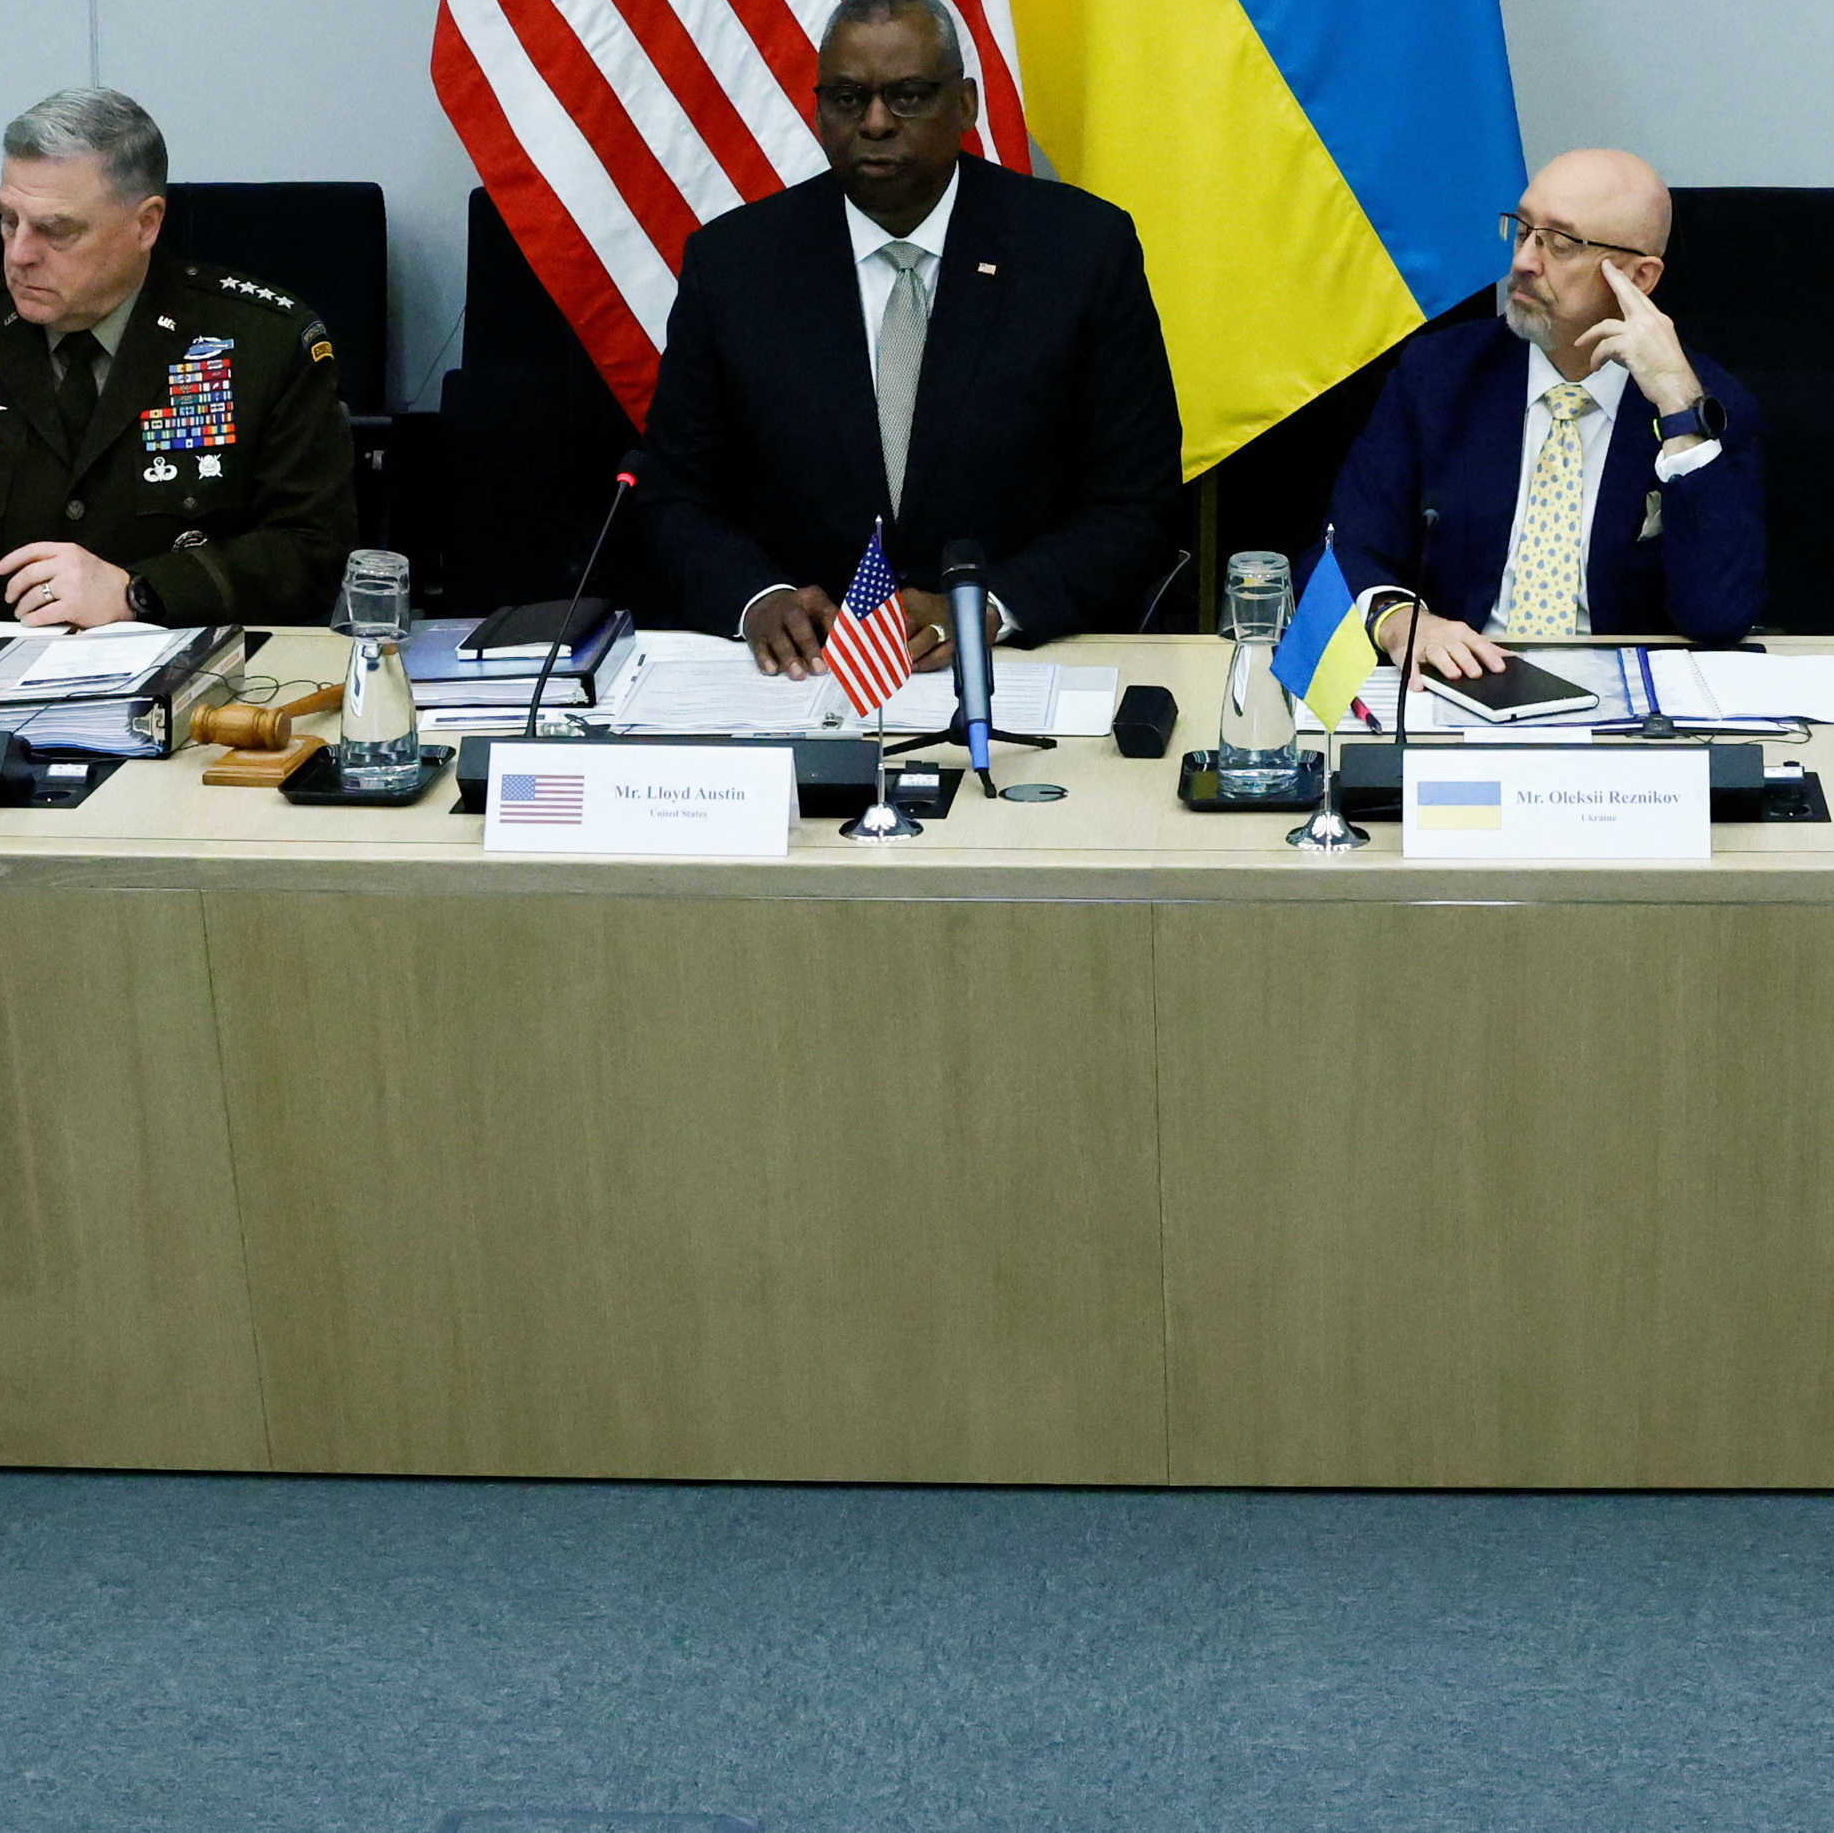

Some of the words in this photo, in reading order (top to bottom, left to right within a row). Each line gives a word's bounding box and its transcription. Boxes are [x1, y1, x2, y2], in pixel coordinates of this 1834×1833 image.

[614, 784, 641, 800] Mr.
[646, 785, 691, 804] Lloyd
[695, 786, 746, 801] Austin
[1515, 790, 1545, 805] Mr.
[1548, 790, 1604, 805] Oleksii
[1608, 790, 1681, 805] Reznikov
[650, 809, 679, 818] United
[681, 809, 708, 819] States
[1580, 813, 1618, 822] Ukraine
